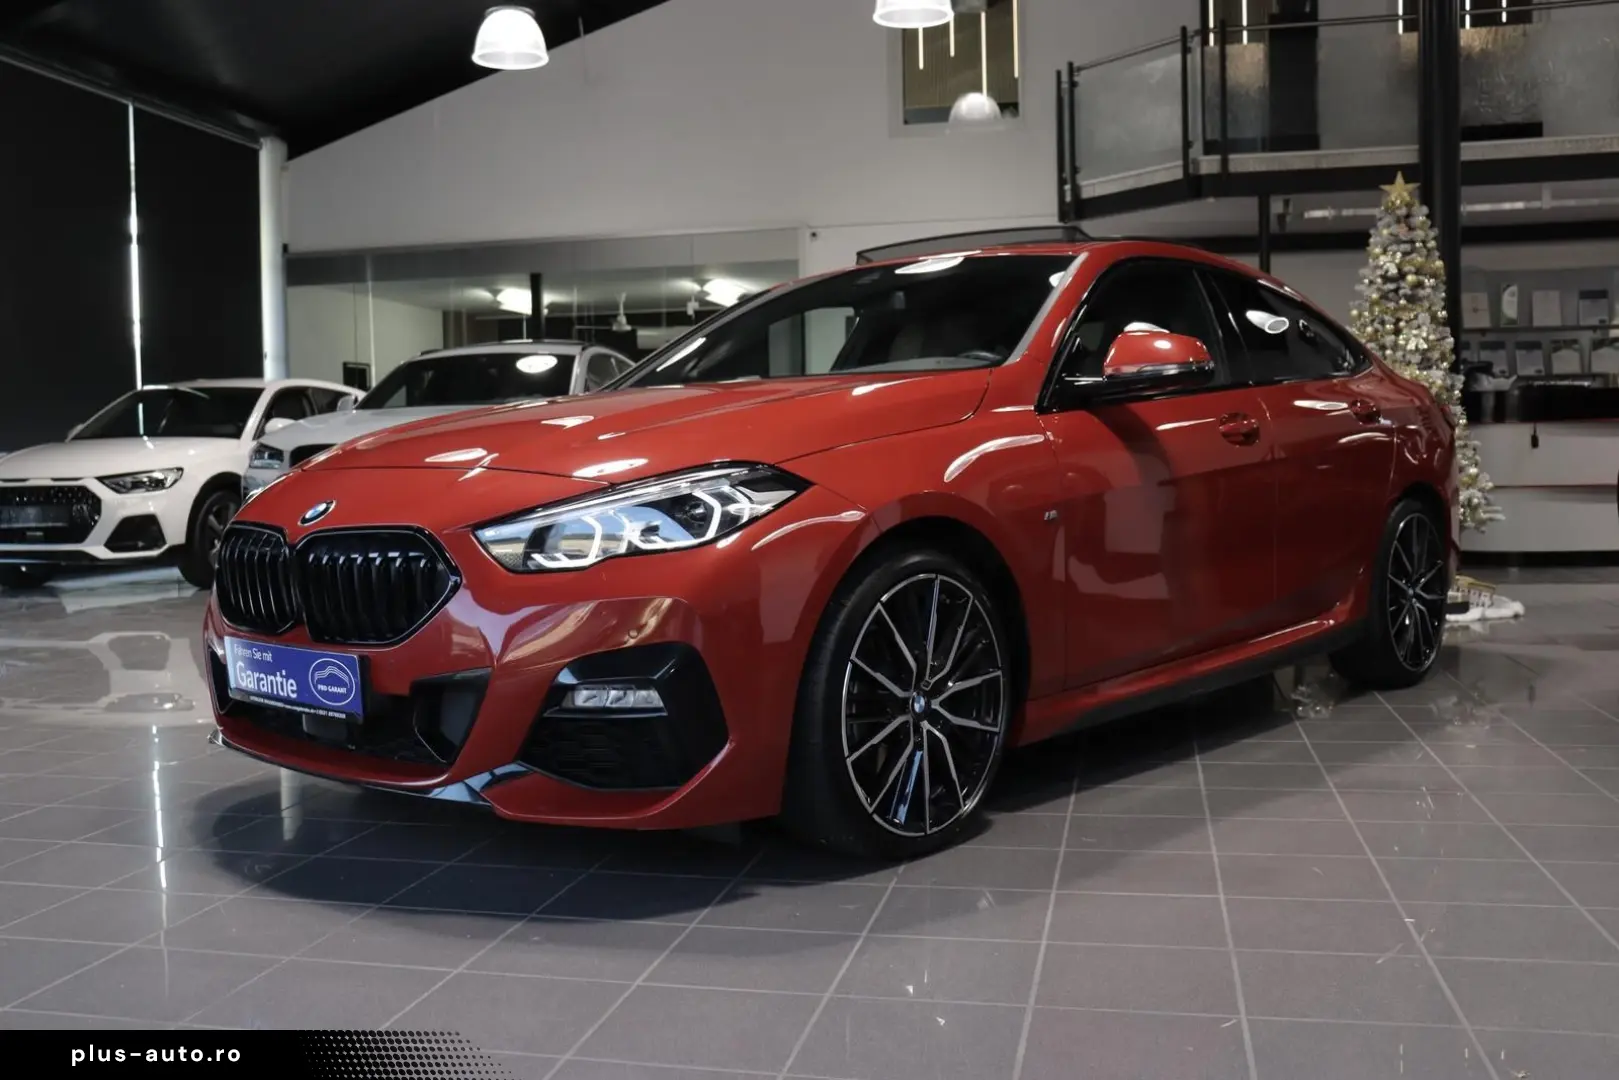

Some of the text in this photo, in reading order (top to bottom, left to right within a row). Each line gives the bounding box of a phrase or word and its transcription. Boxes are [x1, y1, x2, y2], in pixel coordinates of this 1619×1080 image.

[234, 644, 273, 663] Fahren Sie mit
[236, 661, 297, 698] Garantie
[328, 685, 347, 695] GARANT
